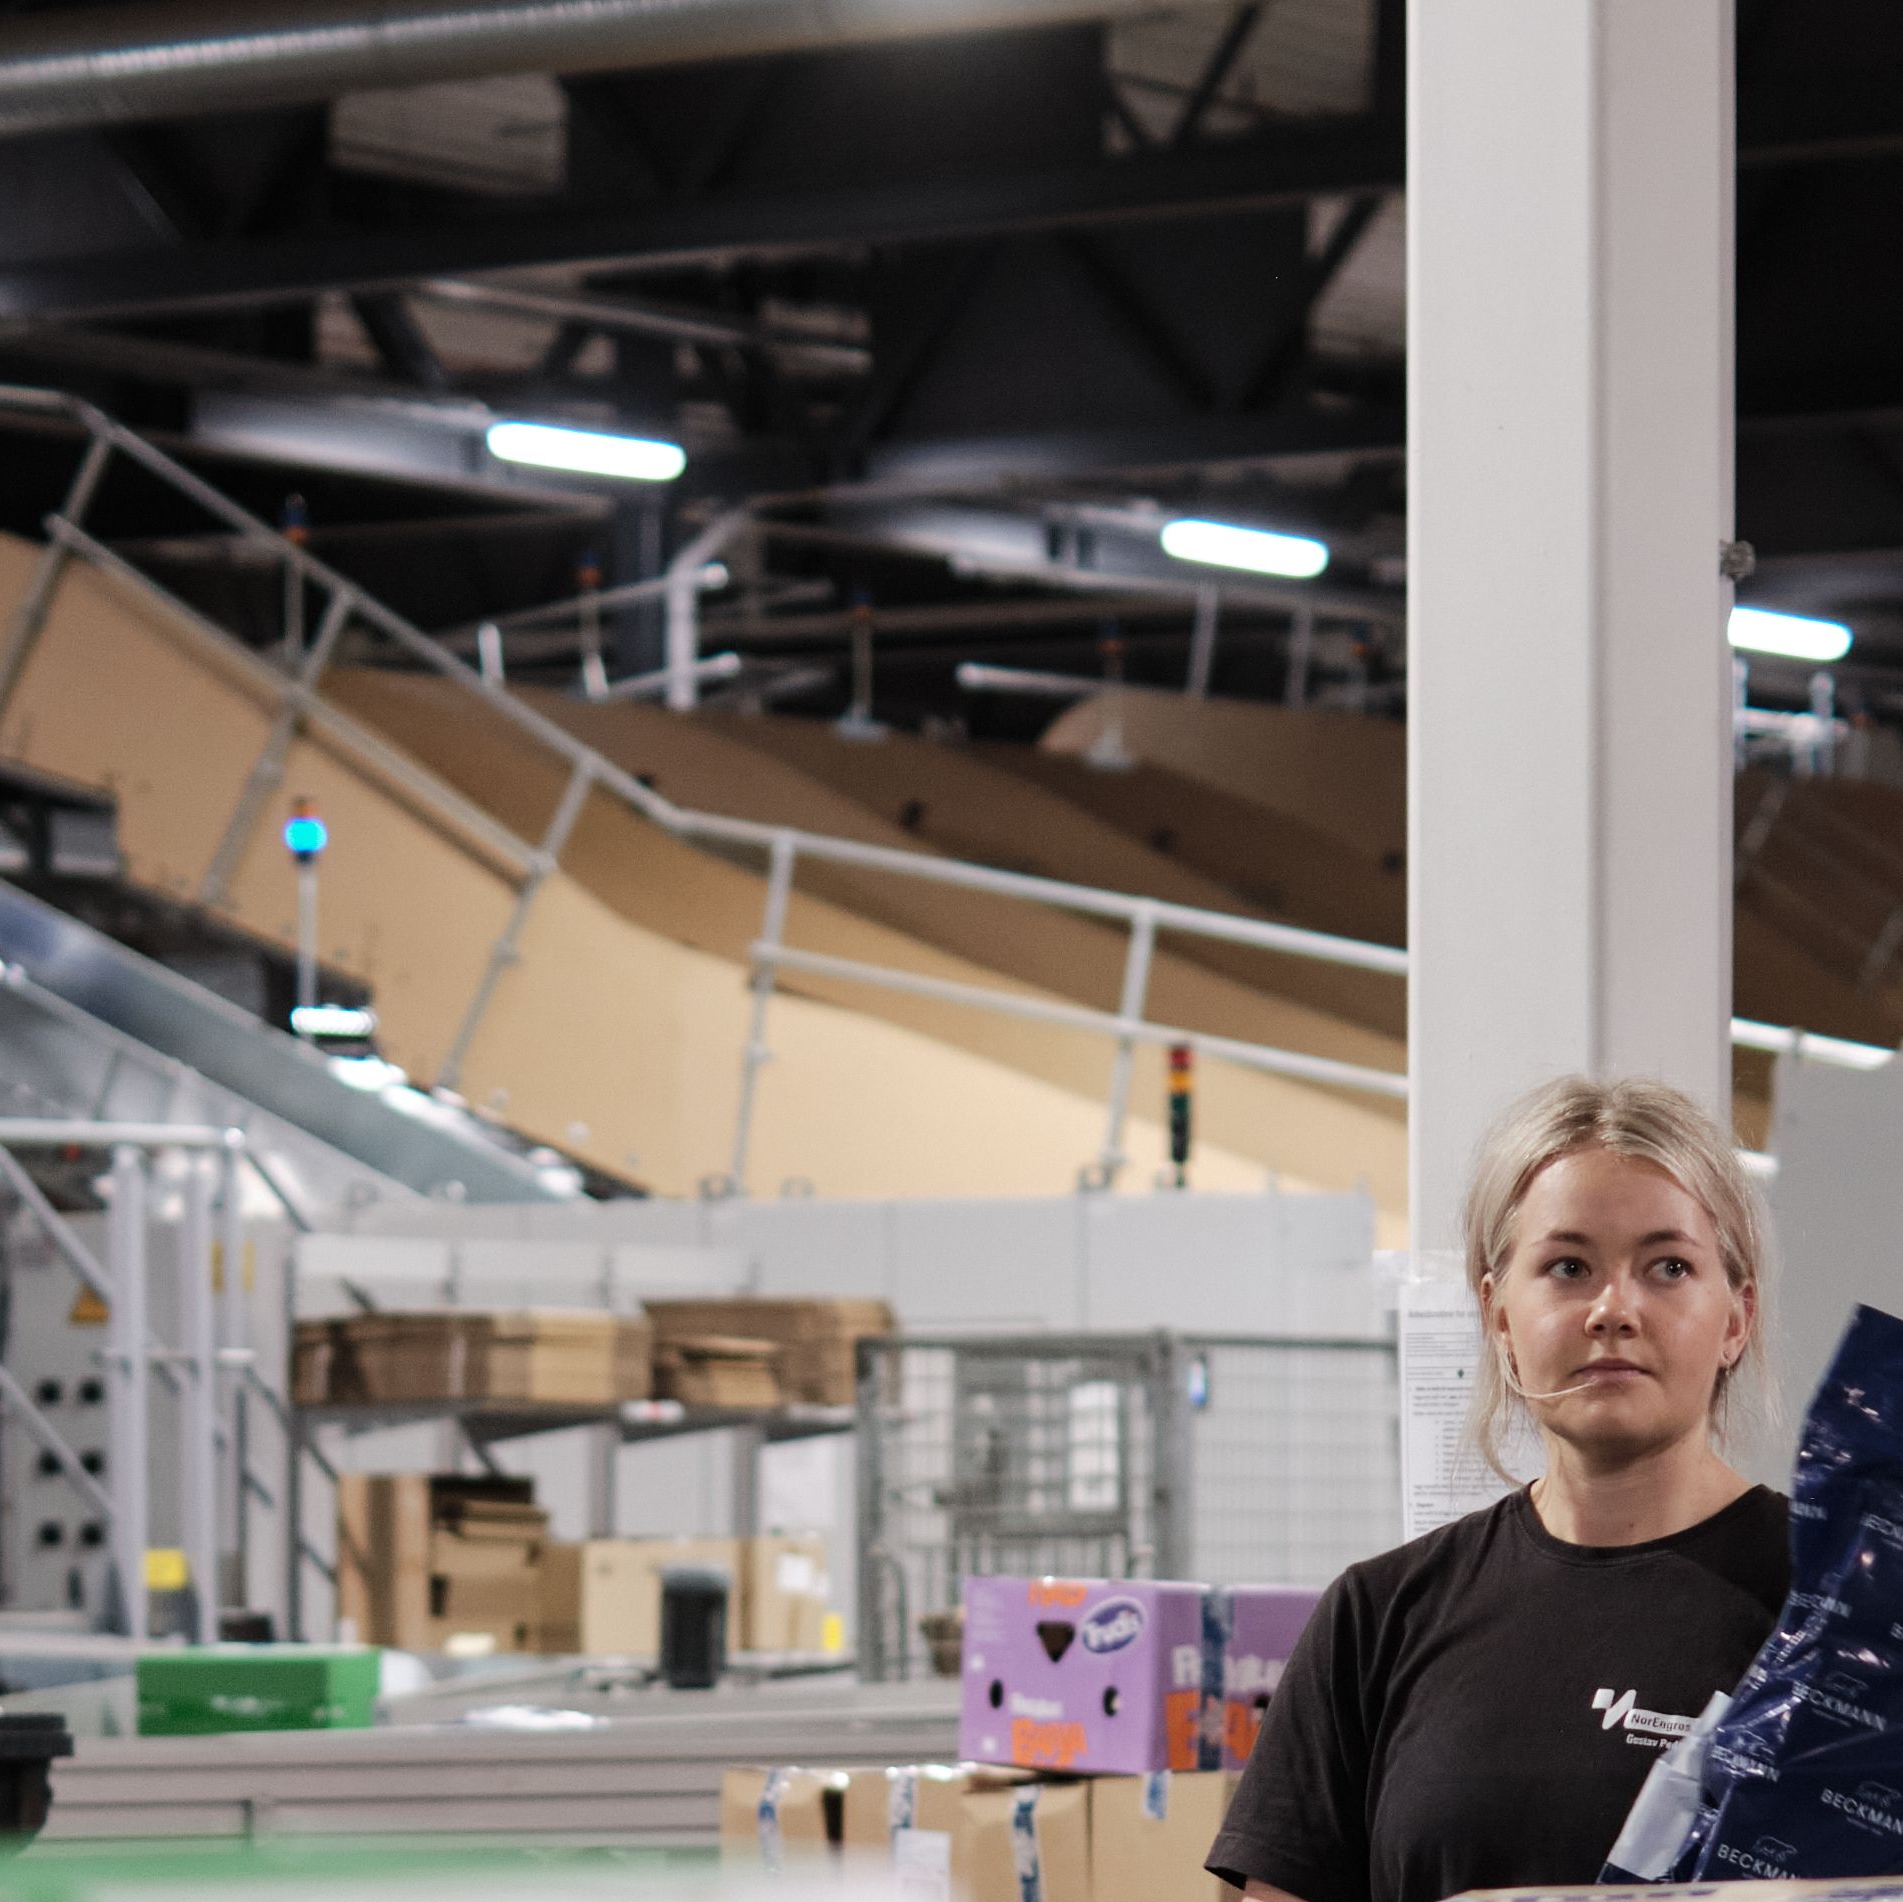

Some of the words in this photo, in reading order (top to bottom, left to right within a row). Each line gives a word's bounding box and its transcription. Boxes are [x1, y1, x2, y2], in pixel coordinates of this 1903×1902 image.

[1630, 1713, 1692, 1733] NorEngros
[1792, 1679, 1888, 1733] BECKMANN
[1717, 1844, 1797, 1880] BECKMA
